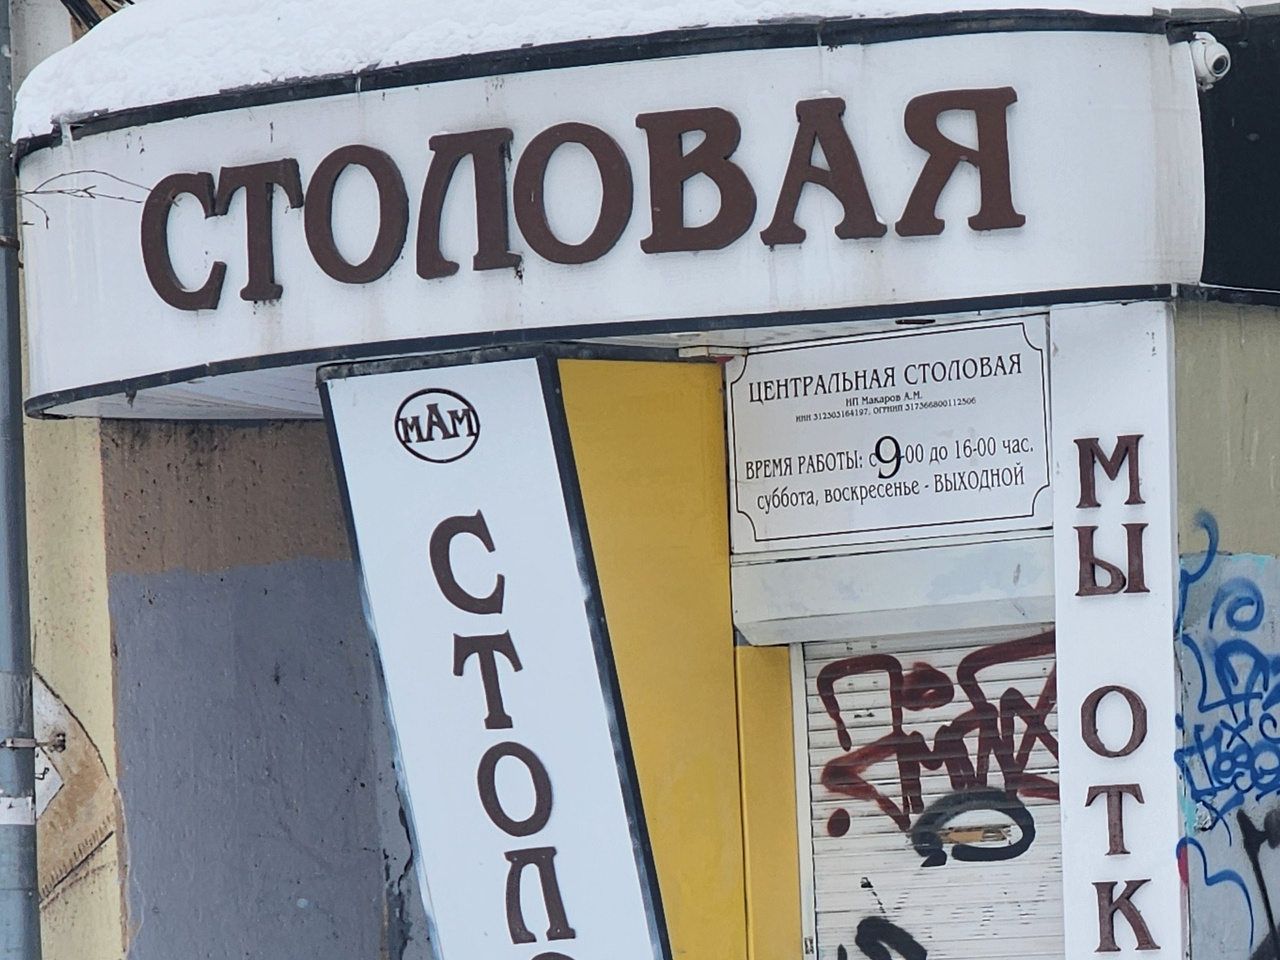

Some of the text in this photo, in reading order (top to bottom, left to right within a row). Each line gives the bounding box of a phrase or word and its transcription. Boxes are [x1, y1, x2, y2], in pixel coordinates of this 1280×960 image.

[141, 86, 1026, 313] СТОЛОВАЯ
[749, 353, 1022, 405] ЦЕНТРАЛЬНАЯ СТОЛОВАЯ
[861, 393, 901, 405] Макаров
[904, 390, 923, 401] А.М.
[399, 403, 477, 443] МАМ
[745, 457, 793, 480] ВРЕМЯ
[798, 450, 863, 475] РАБОТЫ:
[929, 445, 948, 465] до
[955, 436, 996, 459] 16-00
[1002, 437, 1034, 454] час.
[757, 486, 819, 515] суббота,
[824, 480, 920, 505] воскресенье
[934, 461, 1025, 493] ВЫХОДНОЙ
[1073, 434, 1151, 596] МЫ
